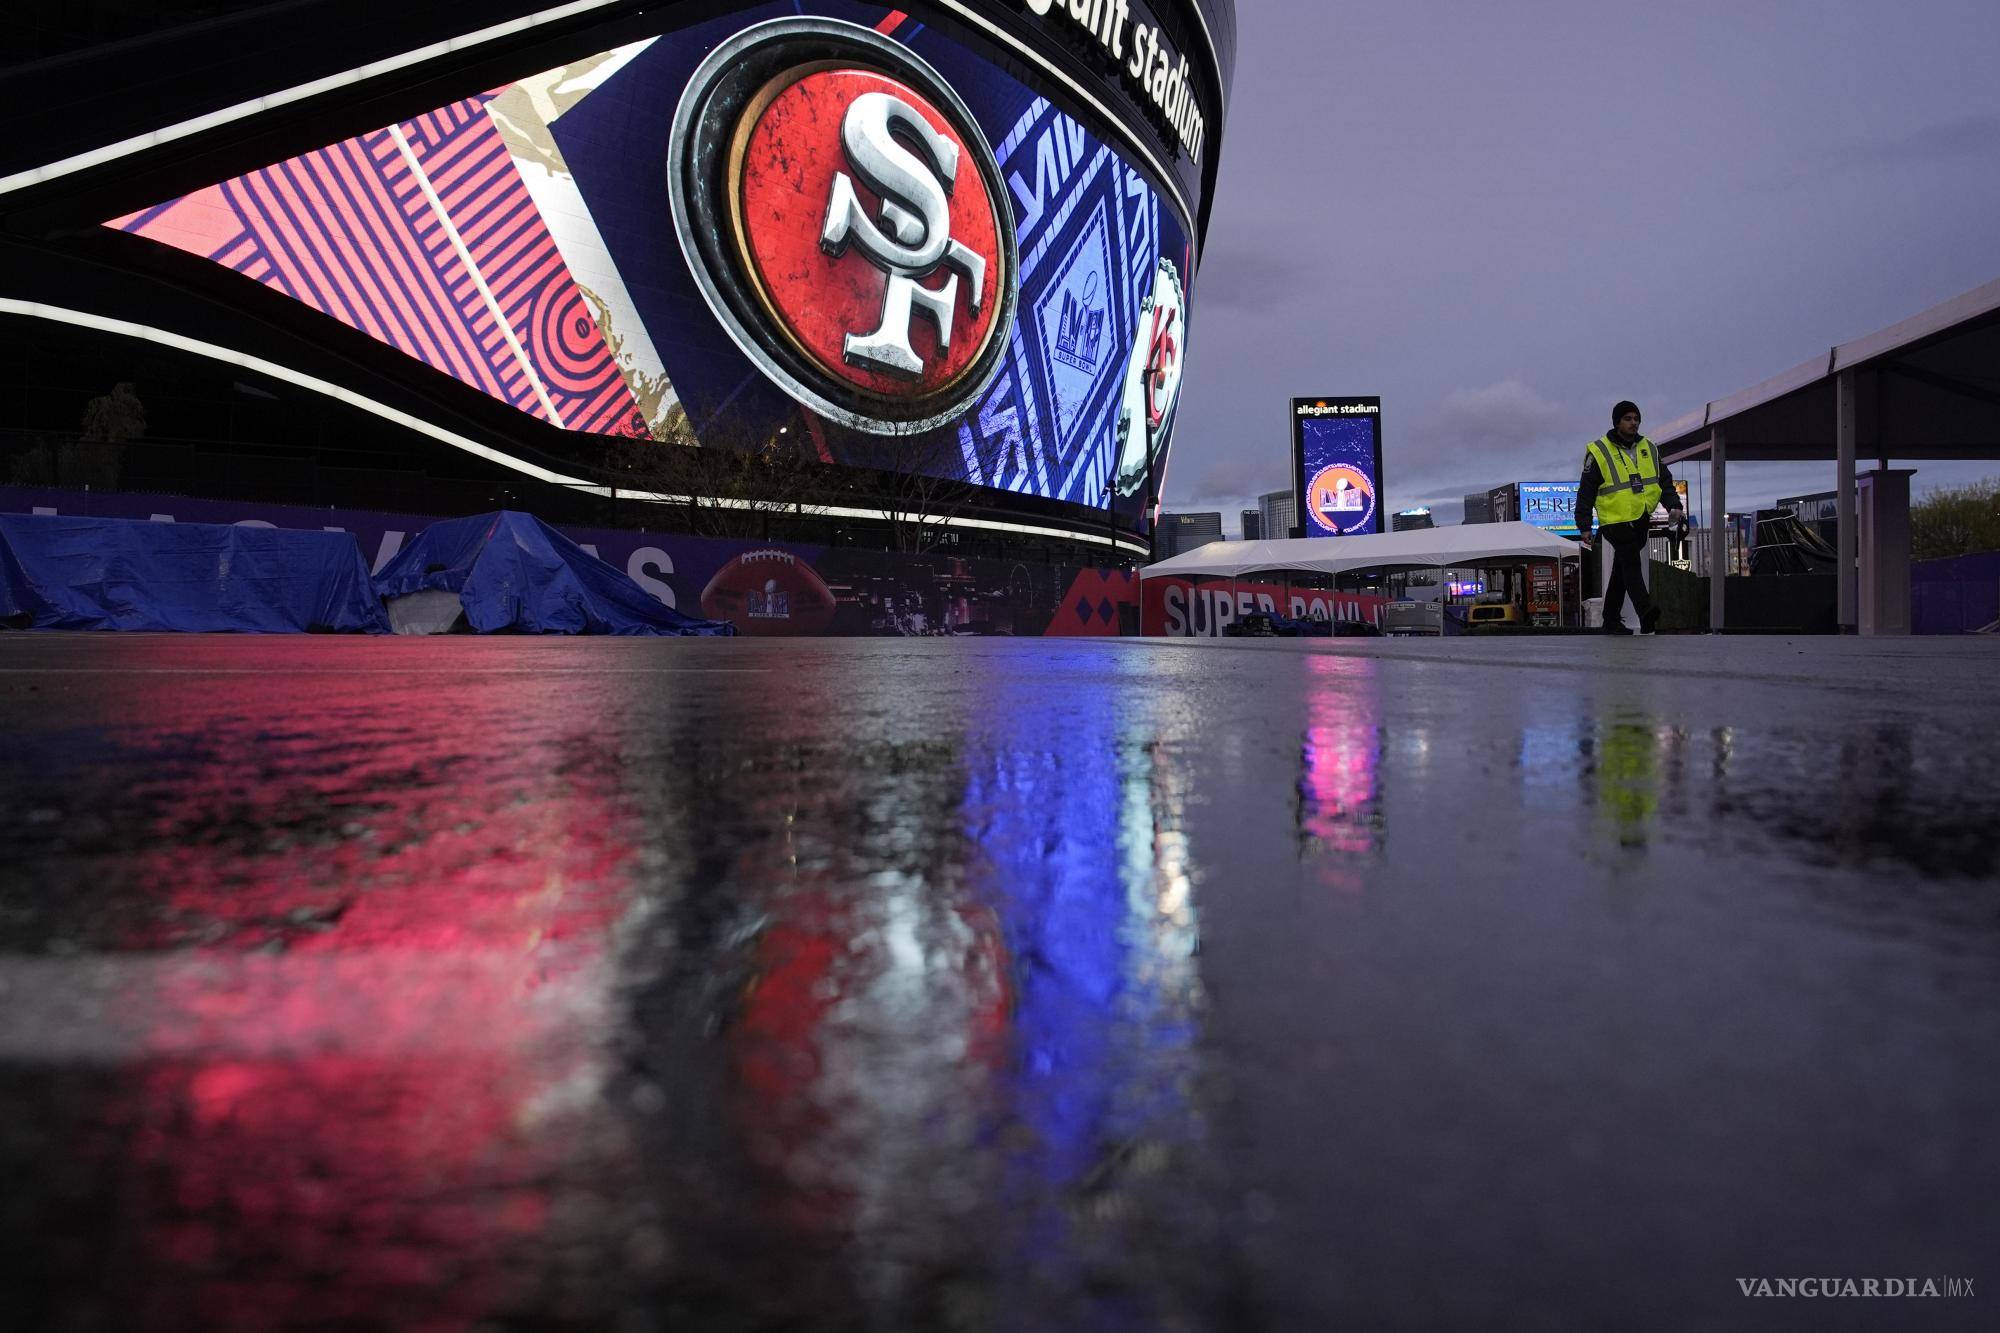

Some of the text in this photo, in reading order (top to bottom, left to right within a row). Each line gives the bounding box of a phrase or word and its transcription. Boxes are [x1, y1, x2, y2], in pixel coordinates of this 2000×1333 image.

[1129, 23, 1204, 166] stadium
[1058, 351, 1093, 372] SUPER BOWL
[1297, 404, 1378, 416] allegiant stadium
[1164, 585, 1275, 636] SUPER
